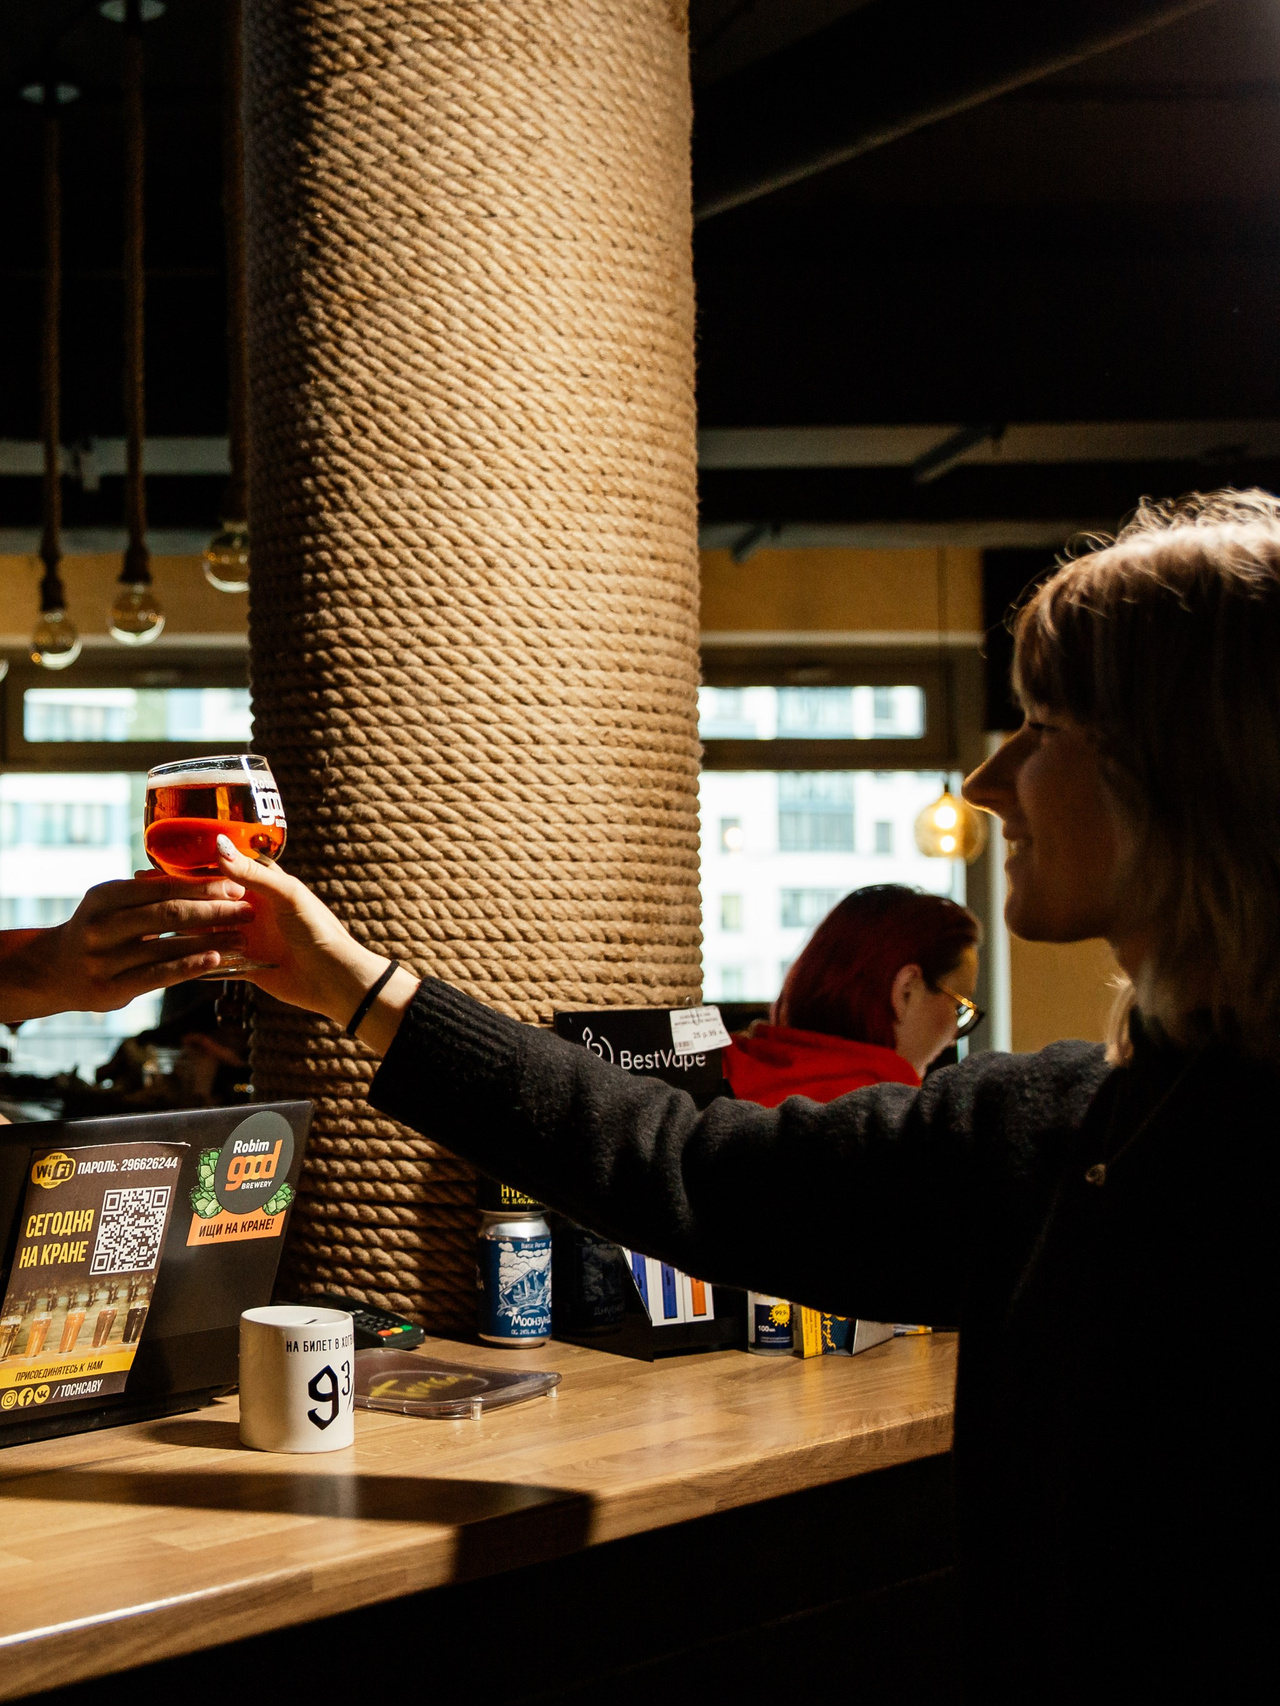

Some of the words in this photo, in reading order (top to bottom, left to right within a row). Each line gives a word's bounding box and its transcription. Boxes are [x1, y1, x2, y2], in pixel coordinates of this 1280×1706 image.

[620, 1048, 707, 1072] BestVape
[233, 1139, 270, 1154] Robim
[77, 1160, 119, 1175] ПАРОЛЬ:
[121, 1156, 179, 1171] 296626244
[225, 1139, 283, 1191] good
[241, 1180, 272, 1190] BREWERY
[25, 1209, 95, 1238] СЕГОДНЯ
[199, 1222, 223, 1238] ИЩИ
[224, 1221, 238, 1235] НА
[240, 1218, 275, 1233] КРАНЕ!
[18, 1246, 38, 1269] НА
[40, 1241, 89, 1266] КРАНЕ
[286, 1340, 299, 1352] НА
[303, 1338, 332, 1352] БИЛЕТ
[334, 1338, 340, 1350] В
[79, 1363, 86, 1373] К
[87, 1360, 104, 1371] НАМ
[61, 1379, 104, 1397] TOCHCABY
